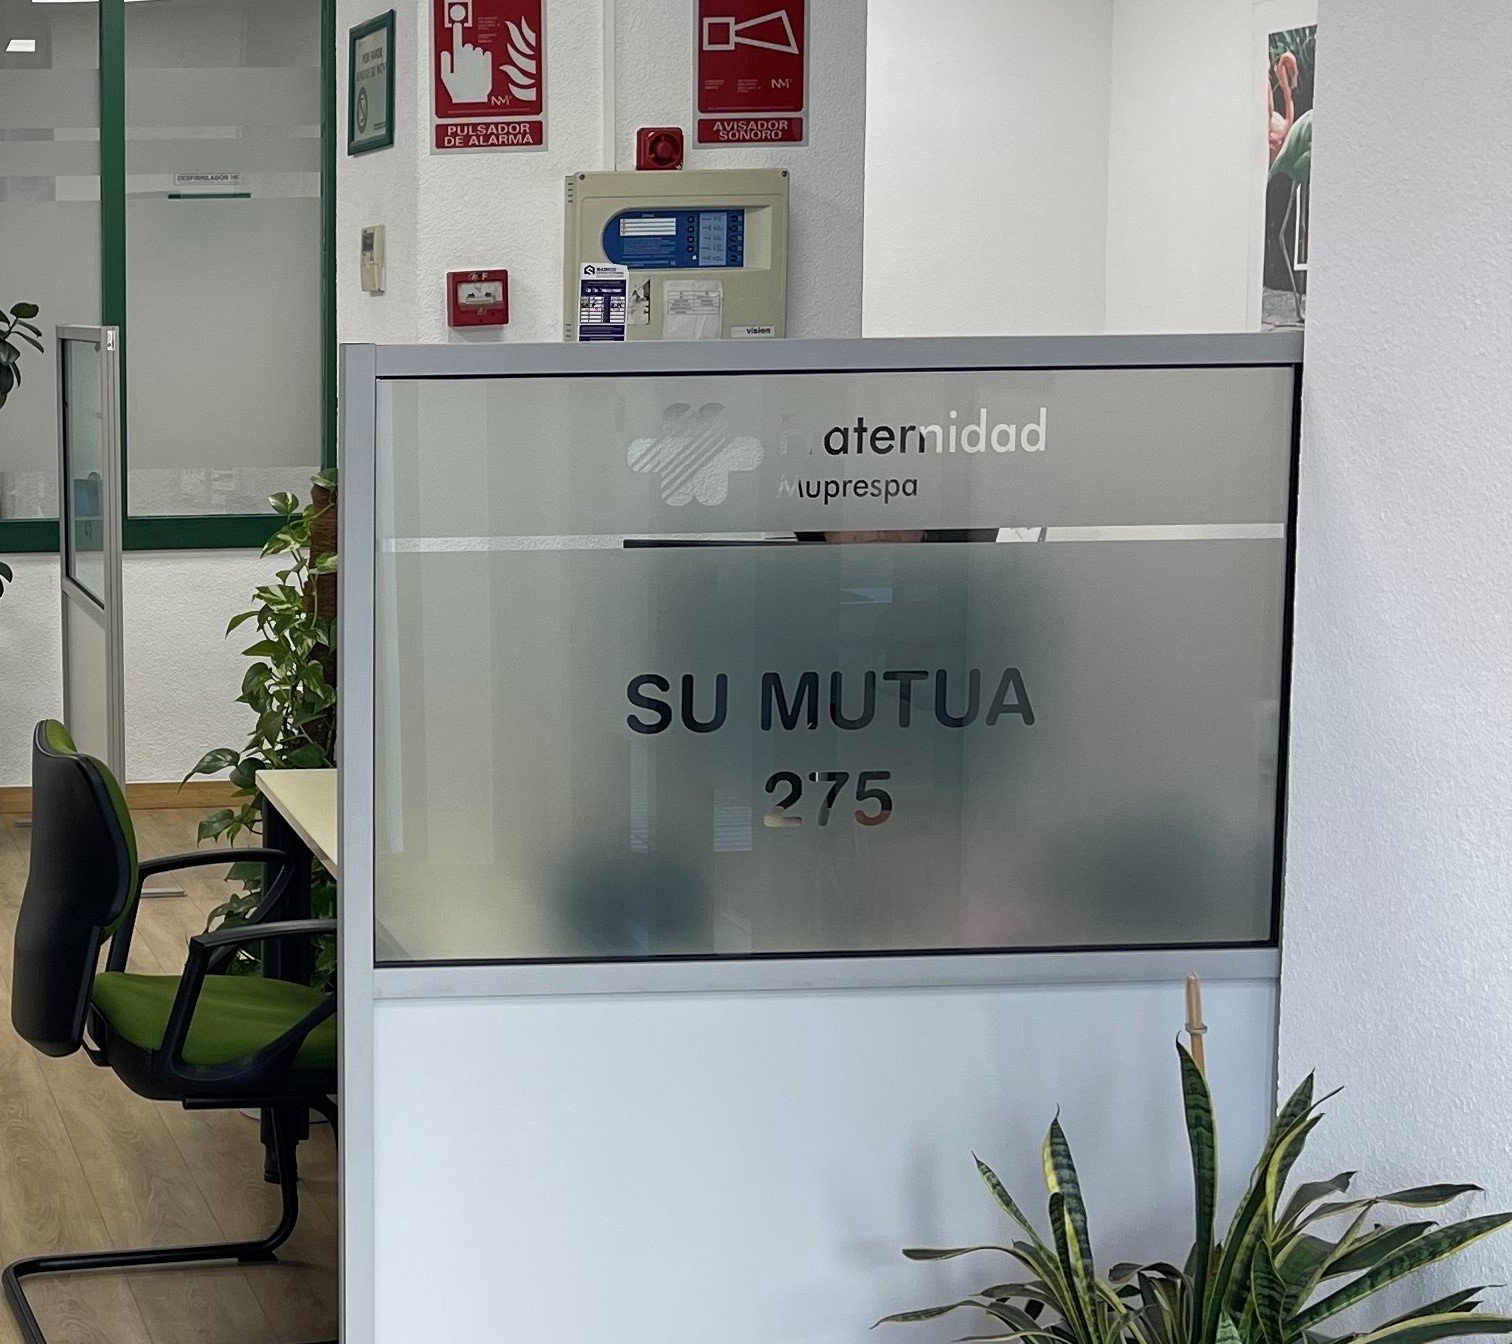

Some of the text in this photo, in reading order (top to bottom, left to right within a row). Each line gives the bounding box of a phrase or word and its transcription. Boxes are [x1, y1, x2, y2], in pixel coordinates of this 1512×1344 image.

[447, 123, 530, 136] PULSADOR
[713, 120, 788, 131] AVISADOR
[445, 134, 534, 147] DE ALARMA
[718, 130, 782, 141] SONORO
[780, 407, 1047, 455] aternidad
[626, 667, 1036, 735] SU MUTUA
[763, 770, 893, 828] 275
